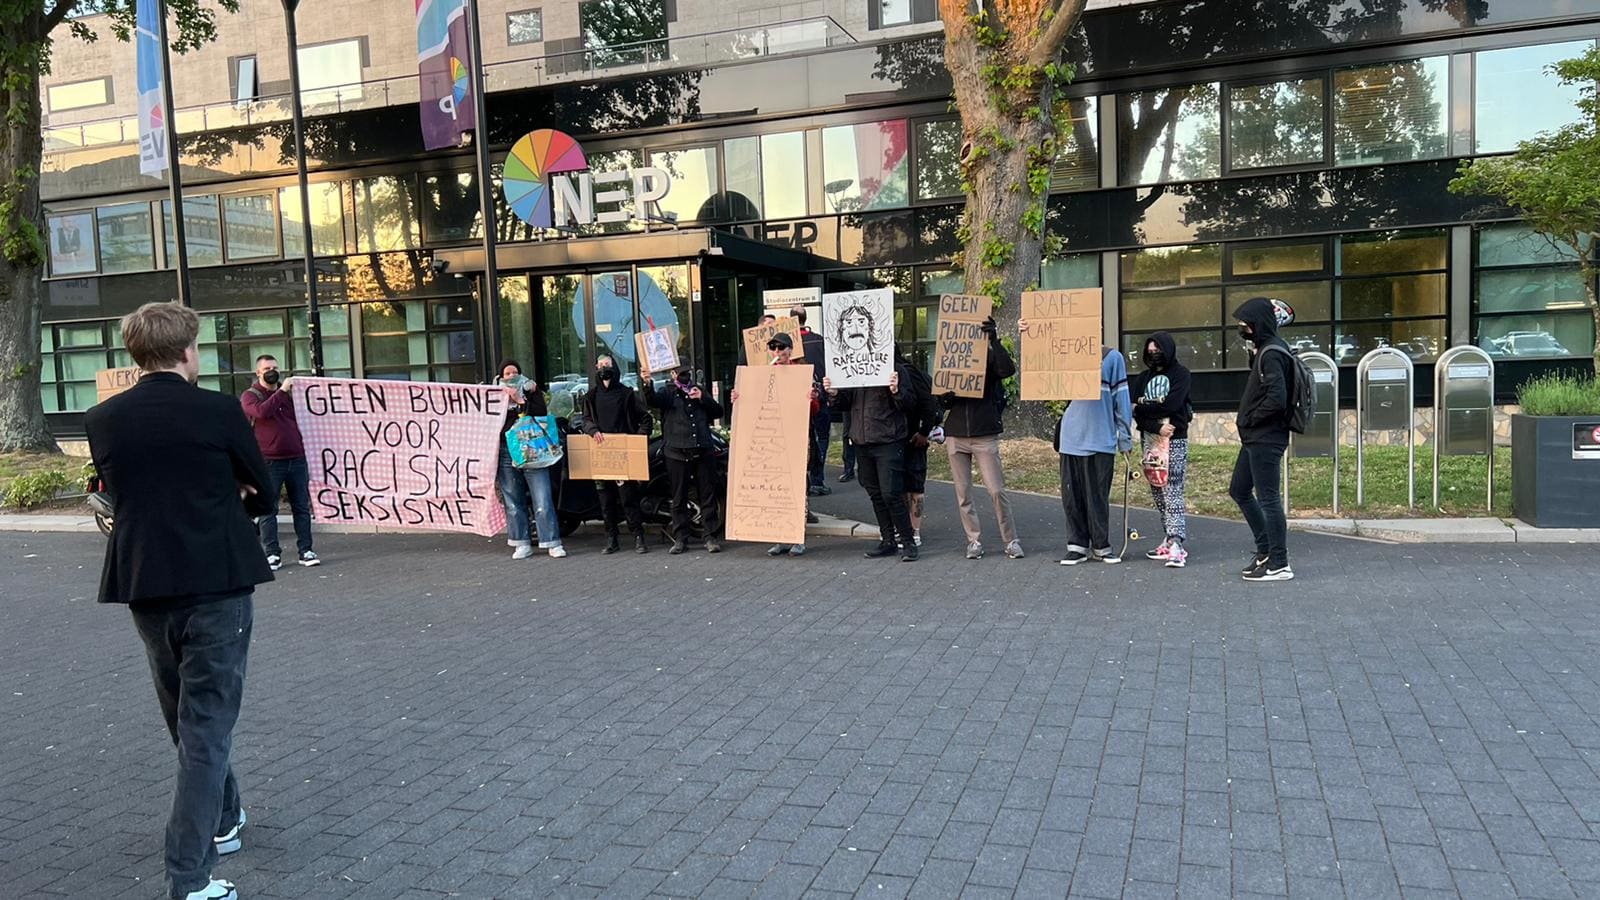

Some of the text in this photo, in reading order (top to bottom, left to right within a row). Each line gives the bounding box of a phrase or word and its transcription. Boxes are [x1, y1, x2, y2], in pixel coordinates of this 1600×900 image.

[553, 167, 671, 228] NEP
[941, 295, 978, 314] GEEN
[1033, 292, 1082, 317] RAPE
[749, 326, 767, 343] STOP
[1027, 321, 1059, 340] CAME
[943, 341, 973, 354] VOOR
[1052, 336, 1097, 355] BEFORE
[832, 352, 888, 367] RAPE CULTURE
[940, 354, 979, 369] RAPE-
[842, 363, 881, 378] INSIDE
[934, 371, 984, 391] CULTURE
[305, 384, 503, 416] GEEN BUHNE
[362, 419, 442, 450] VOOR
[322, 448, 485, 500] RACISME
[318, 489, 473, 526] SEKSISME
